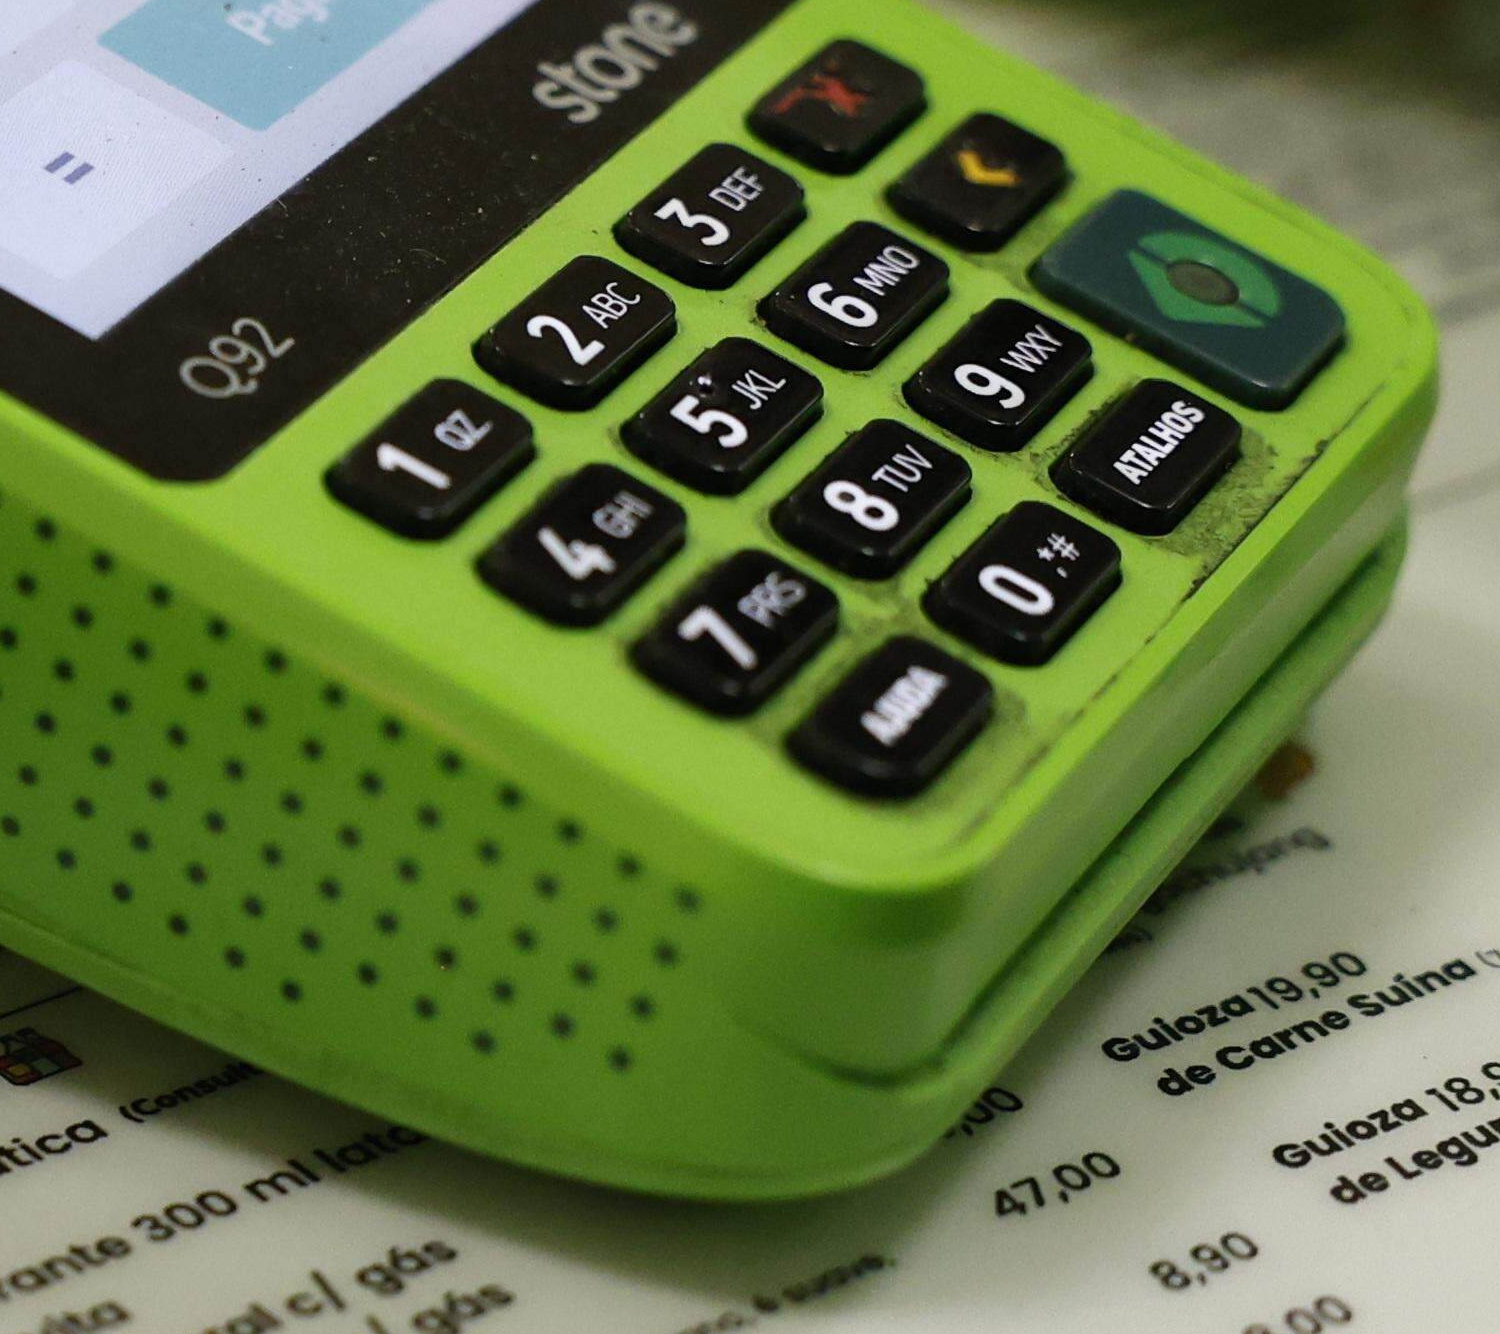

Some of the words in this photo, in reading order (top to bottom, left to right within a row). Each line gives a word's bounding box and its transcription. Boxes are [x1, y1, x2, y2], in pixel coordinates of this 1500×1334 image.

[532, 3, 698, 124] stone
[654, 198, 730, 246] 3
[708, 168, 763, 212] DEF
[527, 314, 604, 366] 2
[583, 282, 641, 329] ABC
[807, 282, 879, 328] 6
[853, 245, 920, 296] MNO
[179, 318, 295, 400] Q92
[954, 363, 1026, 409] 9
[1000, 323, 1063, 373] WXY
[670, 394, 748, 448] 5
[732, 369, 787, 410] JKL
[1113, 400, 1205, 485] ATALHOS
[376, 442, 451, 489] 1
[434, 409, 493, 451] QZ
[823, 480, 899, 531] 8
[872, 444, 933, 493] TUV
[538, 527, 615, 579] 4
[977, 565, 1053, 618] 0
[678, 605, 757, 669] 7
[1101, 991, 1254, 1063] Guioza
[1250, 951, 1367, 1015] 19,90
[1156, 1059, 1217, 1097] de
[1215, 1007, 1352, 1073] Carne
[1348, 955, 1476, 1018] Suína
[1272, 1097, 1428, 1169] Guioza
[131, 1190, 238, 1242] 300
[243, 1158, 321, 1202] ml
[994, 1152, 1121, 1217] 47,00
[1330, 1168, 1391, 1205] de
[353, 1236, 460, 1296] gás
[1149, 1232, 1258, 1291] 8,90
